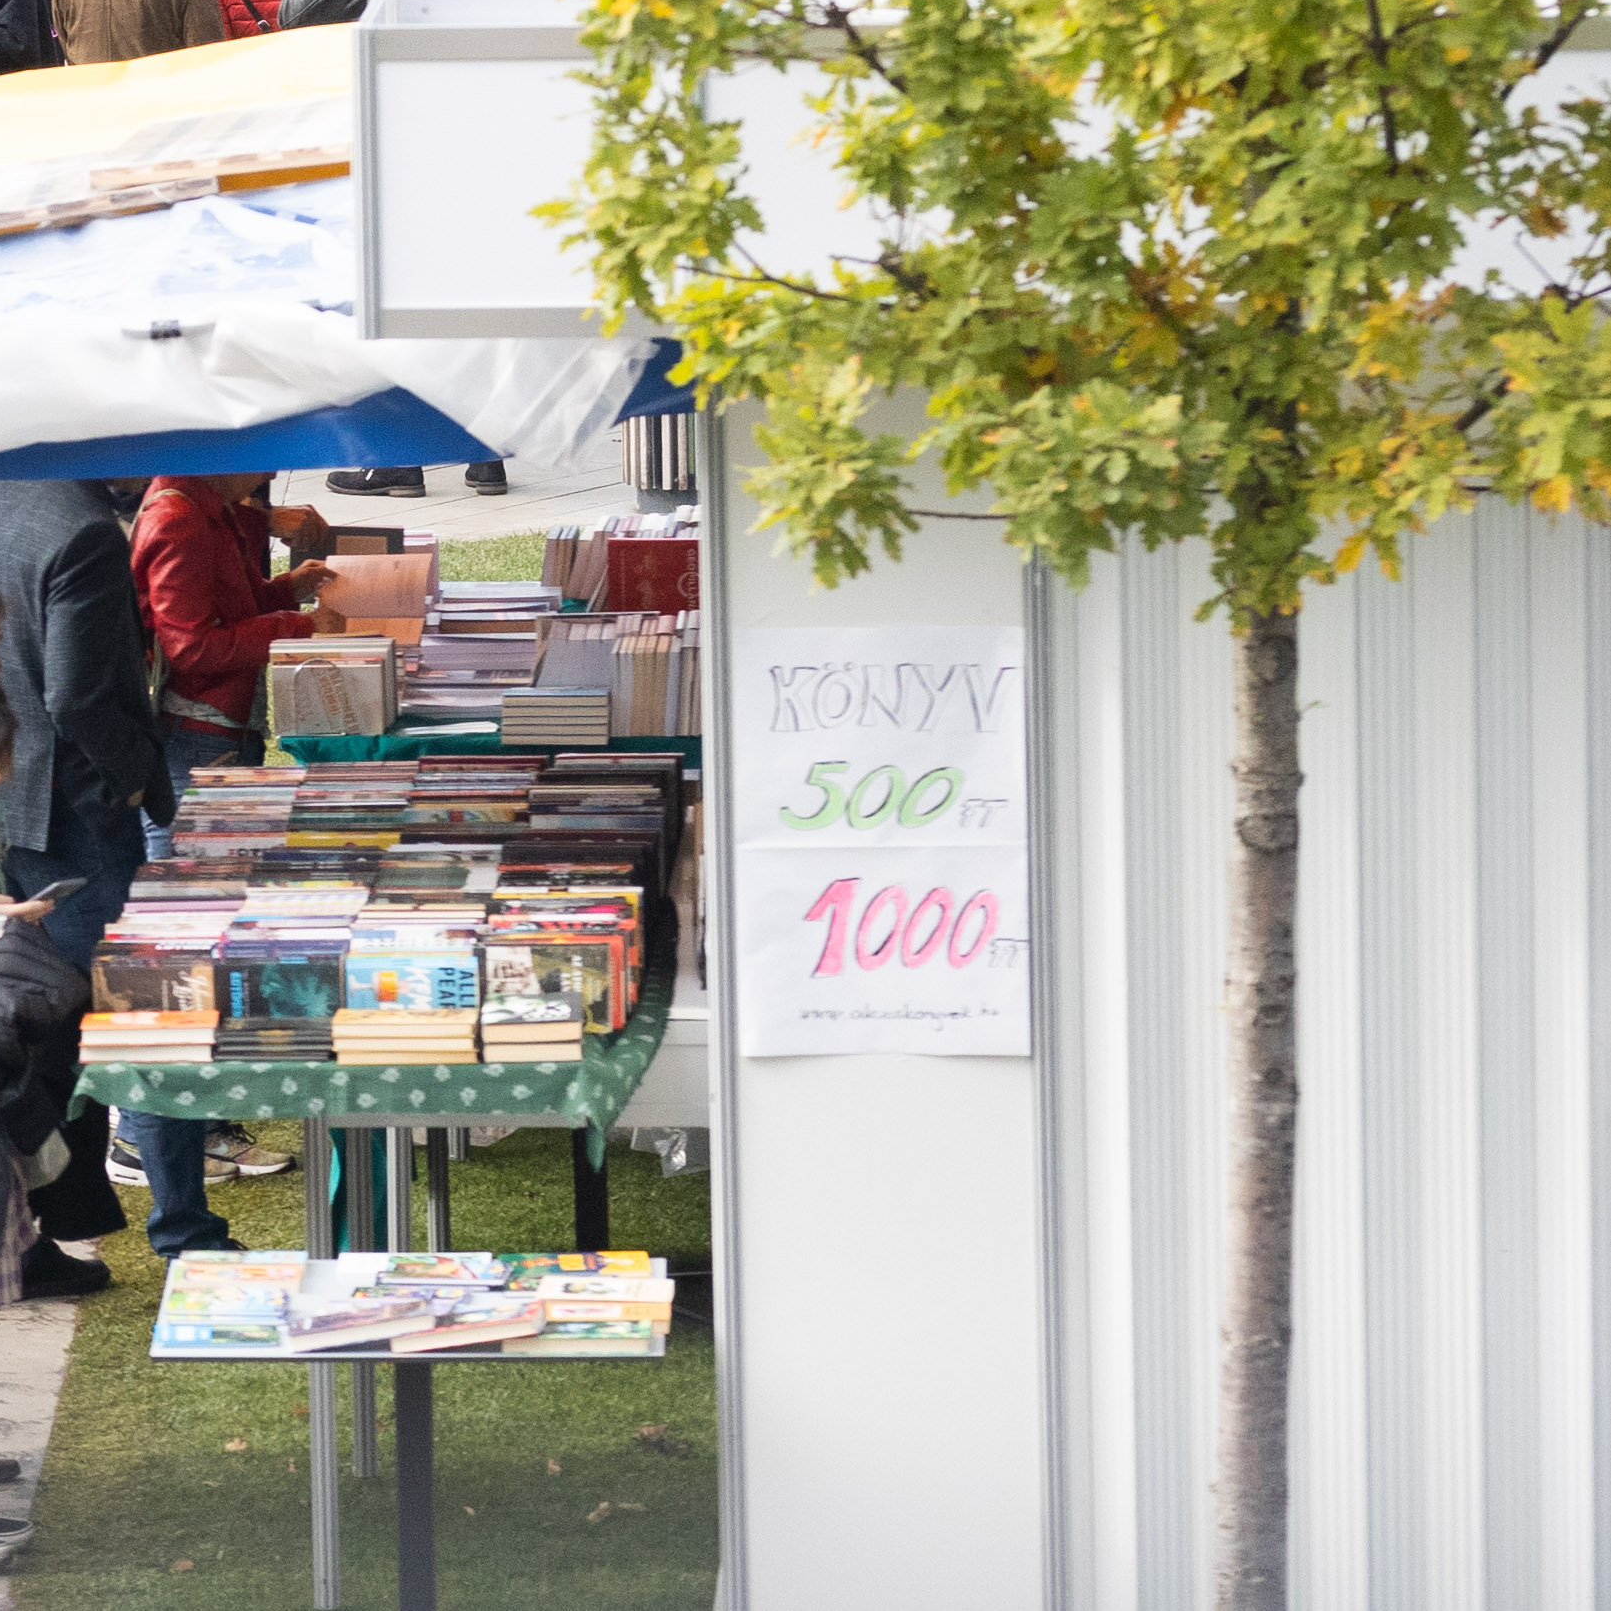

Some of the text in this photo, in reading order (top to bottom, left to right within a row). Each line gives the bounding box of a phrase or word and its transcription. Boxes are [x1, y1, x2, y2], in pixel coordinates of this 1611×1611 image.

[769, 660, 1019, 733] KÖNYV
[780, 760, 964, 829] 500
[803, 877, 1000, 979] 1000
